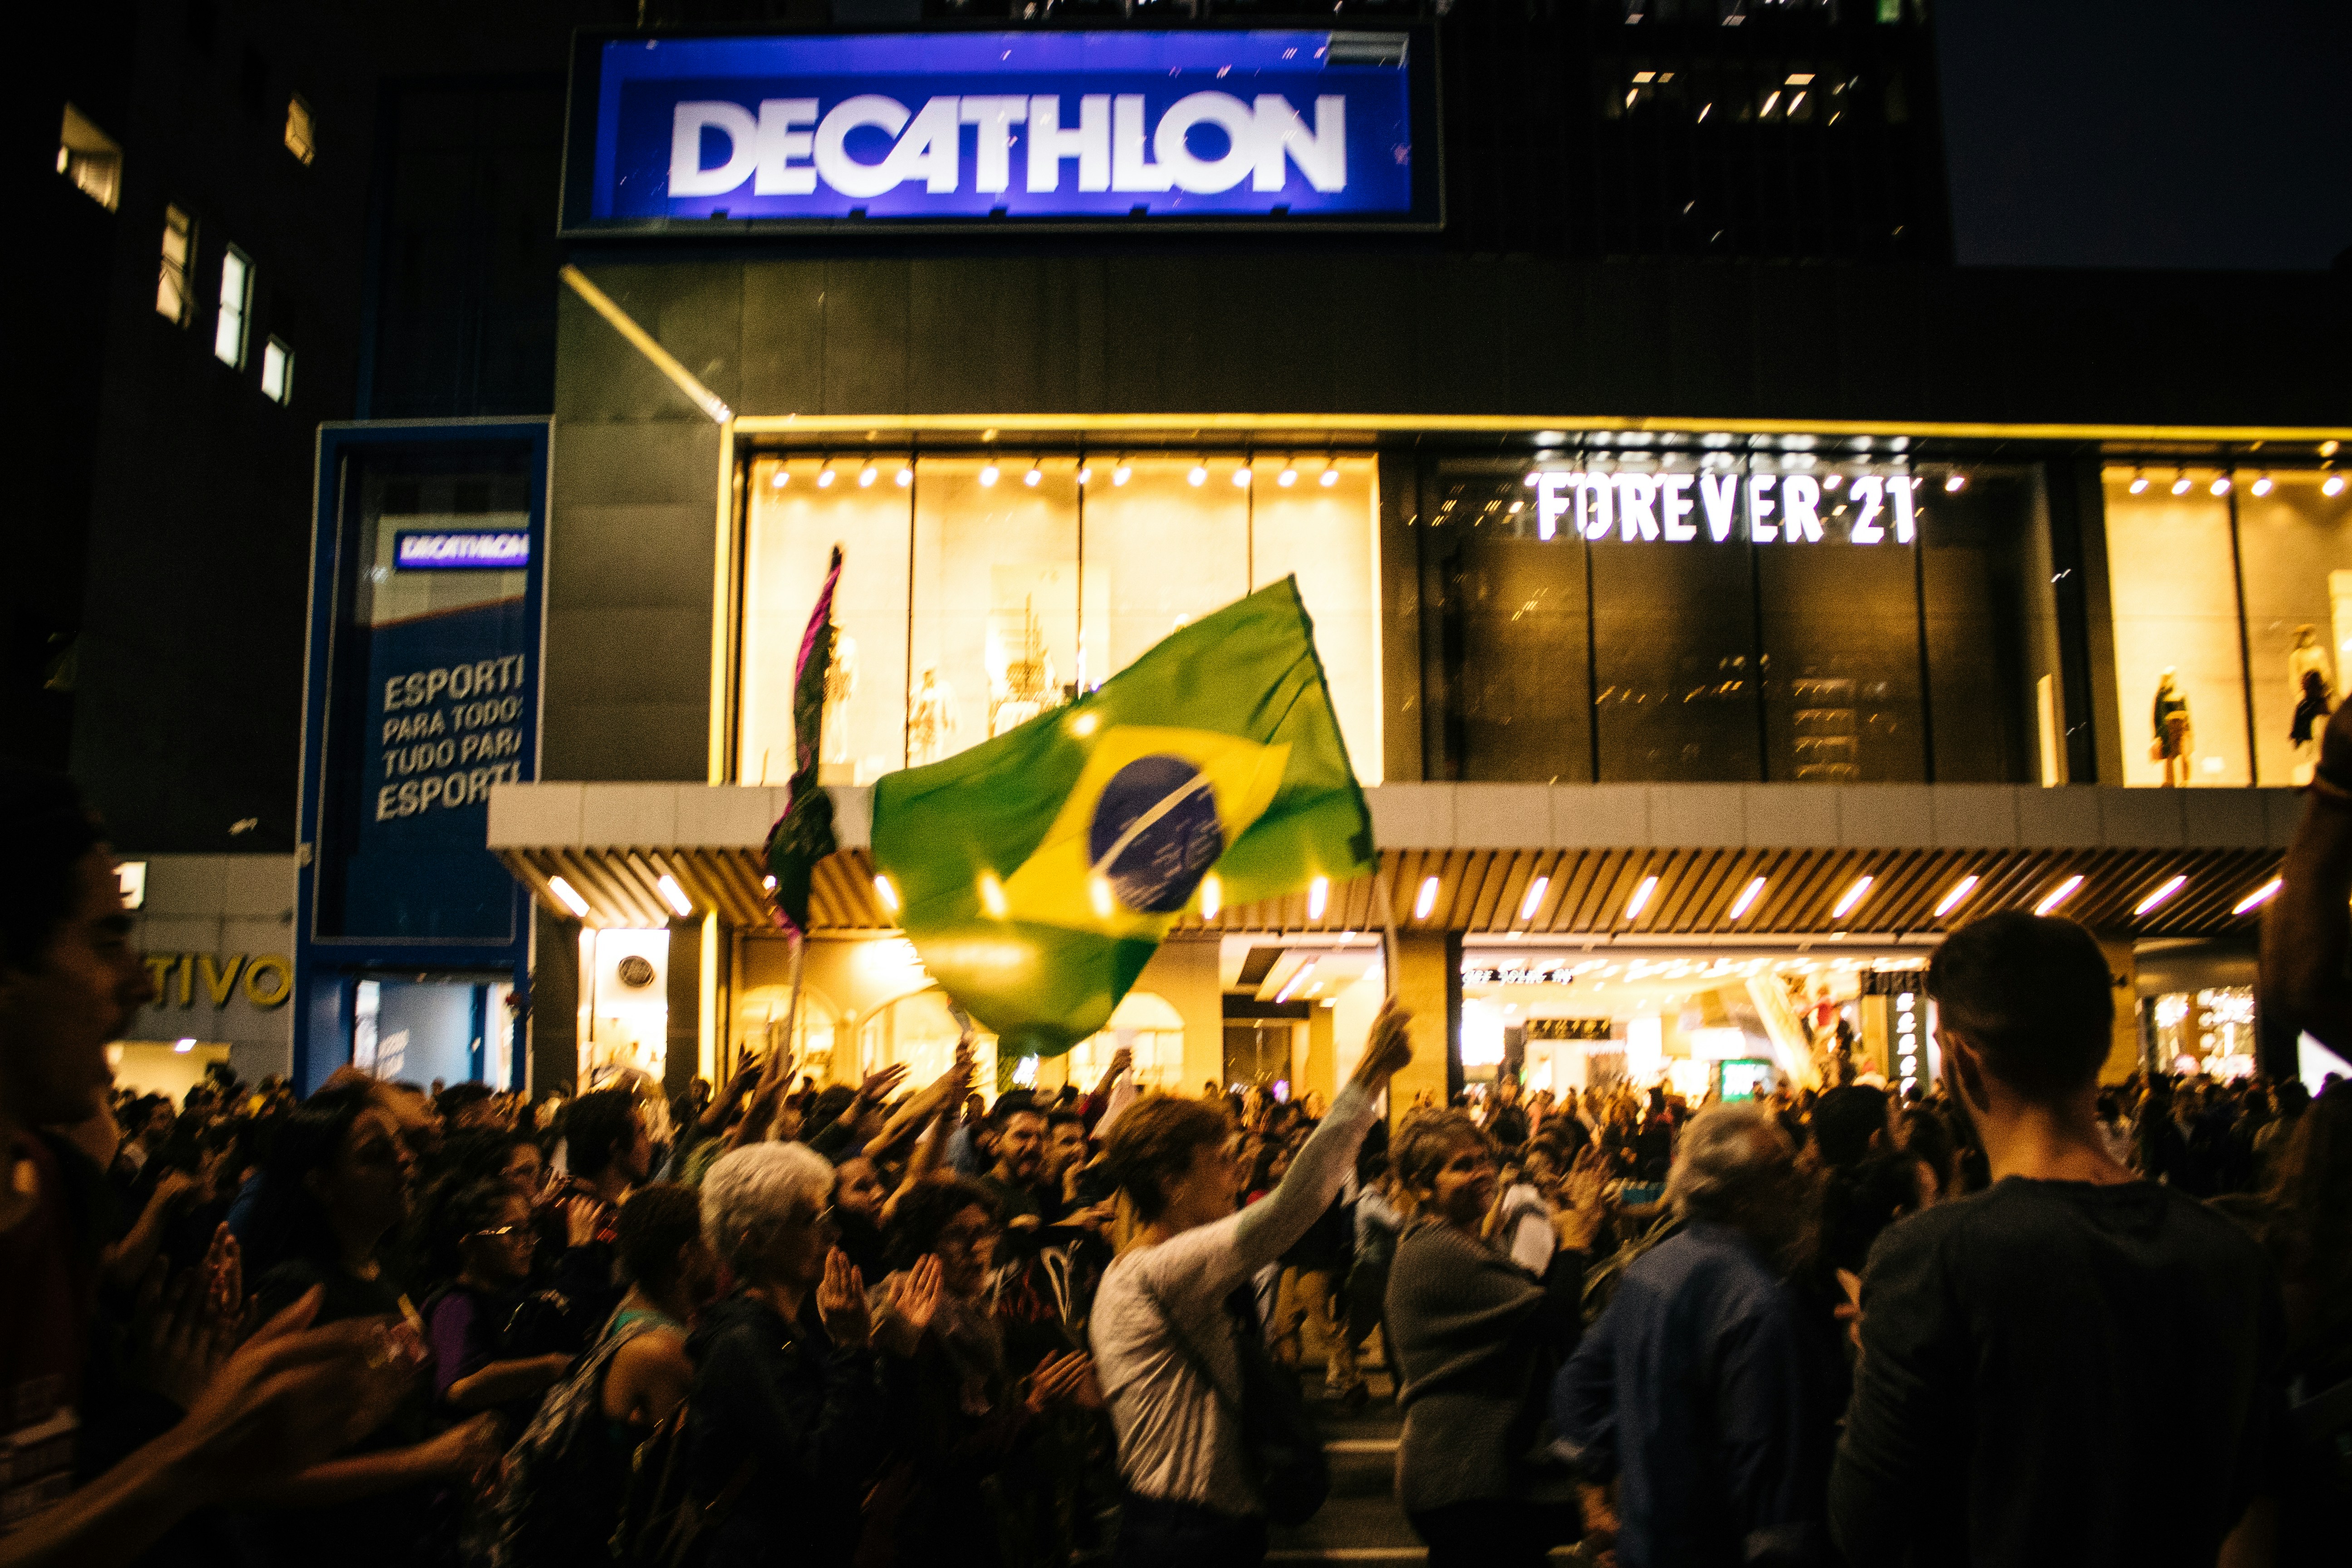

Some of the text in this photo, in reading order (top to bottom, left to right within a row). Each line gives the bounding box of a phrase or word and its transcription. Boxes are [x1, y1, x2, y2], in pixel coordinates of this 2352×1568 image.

[667, 90, 1346, 199] DECATHLON
[1536, 471, 1915, 544] FOREVER 21
[382, 695, 524, 746] PARA TODO
[382, 738, 455, 779] TUDO
